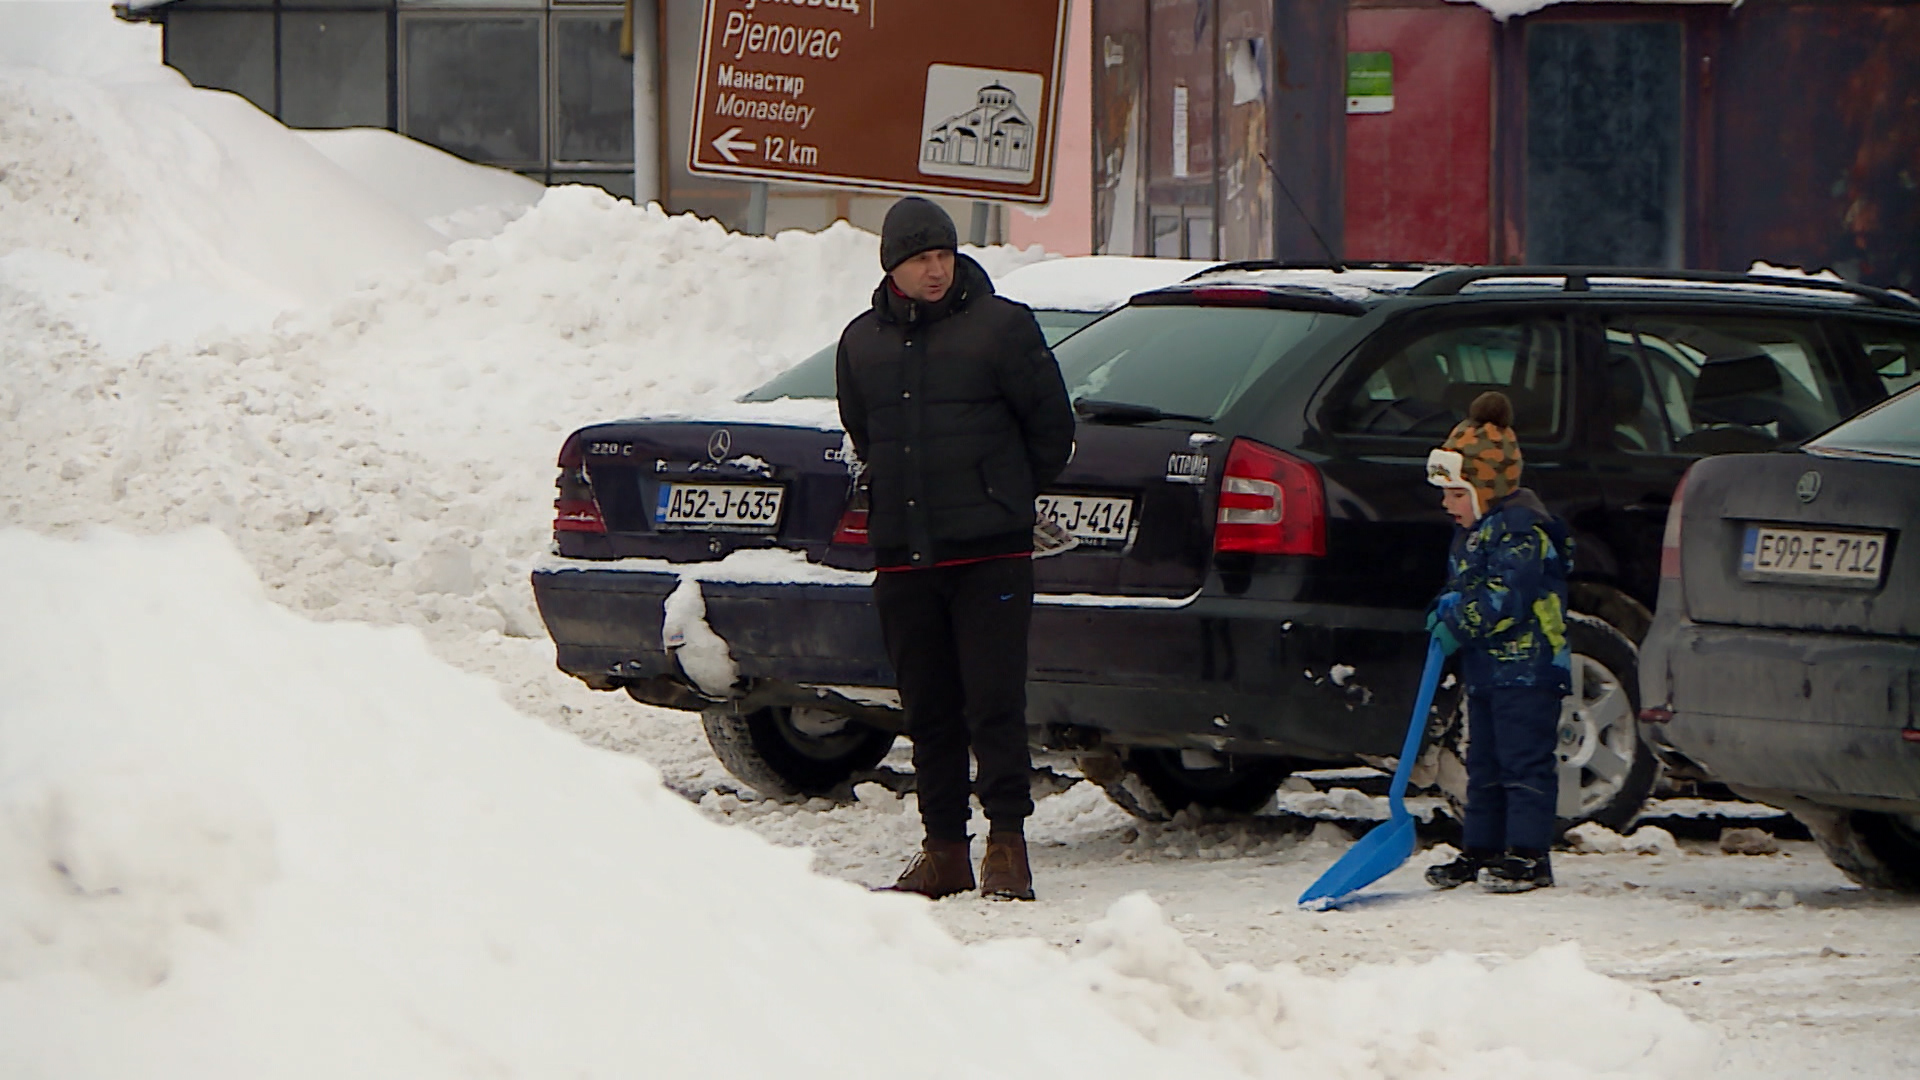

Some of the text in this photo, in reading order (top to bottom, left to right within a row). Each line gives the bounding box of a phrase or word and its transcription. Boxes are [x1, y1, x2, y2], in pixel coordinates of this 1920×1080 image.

[721, 11, 842, 59] Pjenovac
[717, 63, 804, 99] Манастир
[715, 92, 816, 129] Monastery
[764, 135, 818, 165] 12 km
[591, 442, 633, 456] 220 C
[669, 488, 780, 520] A52-J-635
[1758, 534, 1879, 573] E99-E-712
